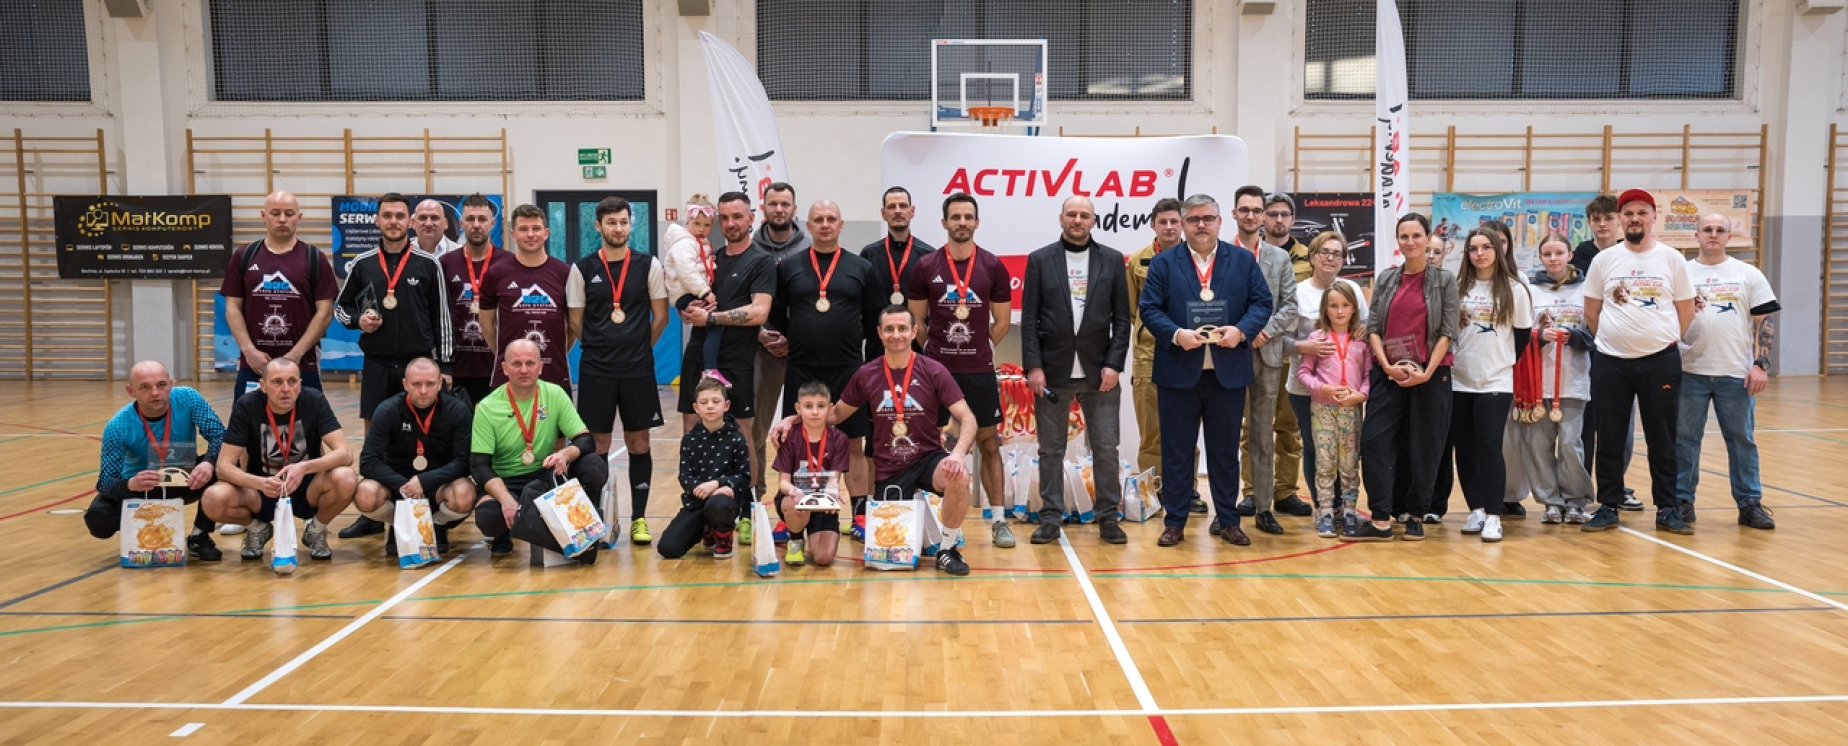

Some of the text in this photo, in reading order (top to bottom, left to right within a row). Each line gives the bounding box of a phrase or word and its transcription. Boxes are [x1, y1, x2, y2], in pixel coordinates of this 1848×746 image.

[943, 158, 1157, 197] ACTIVLAB
[339, 201, 378, 212] MOBIL
[1304, 198, 1360, 208] Leksandrowa
[1461, 198, 1522, 210] electroVit
[111, 211, 211, 229] MatKomp
[339, 213, 377, 225] SERW
